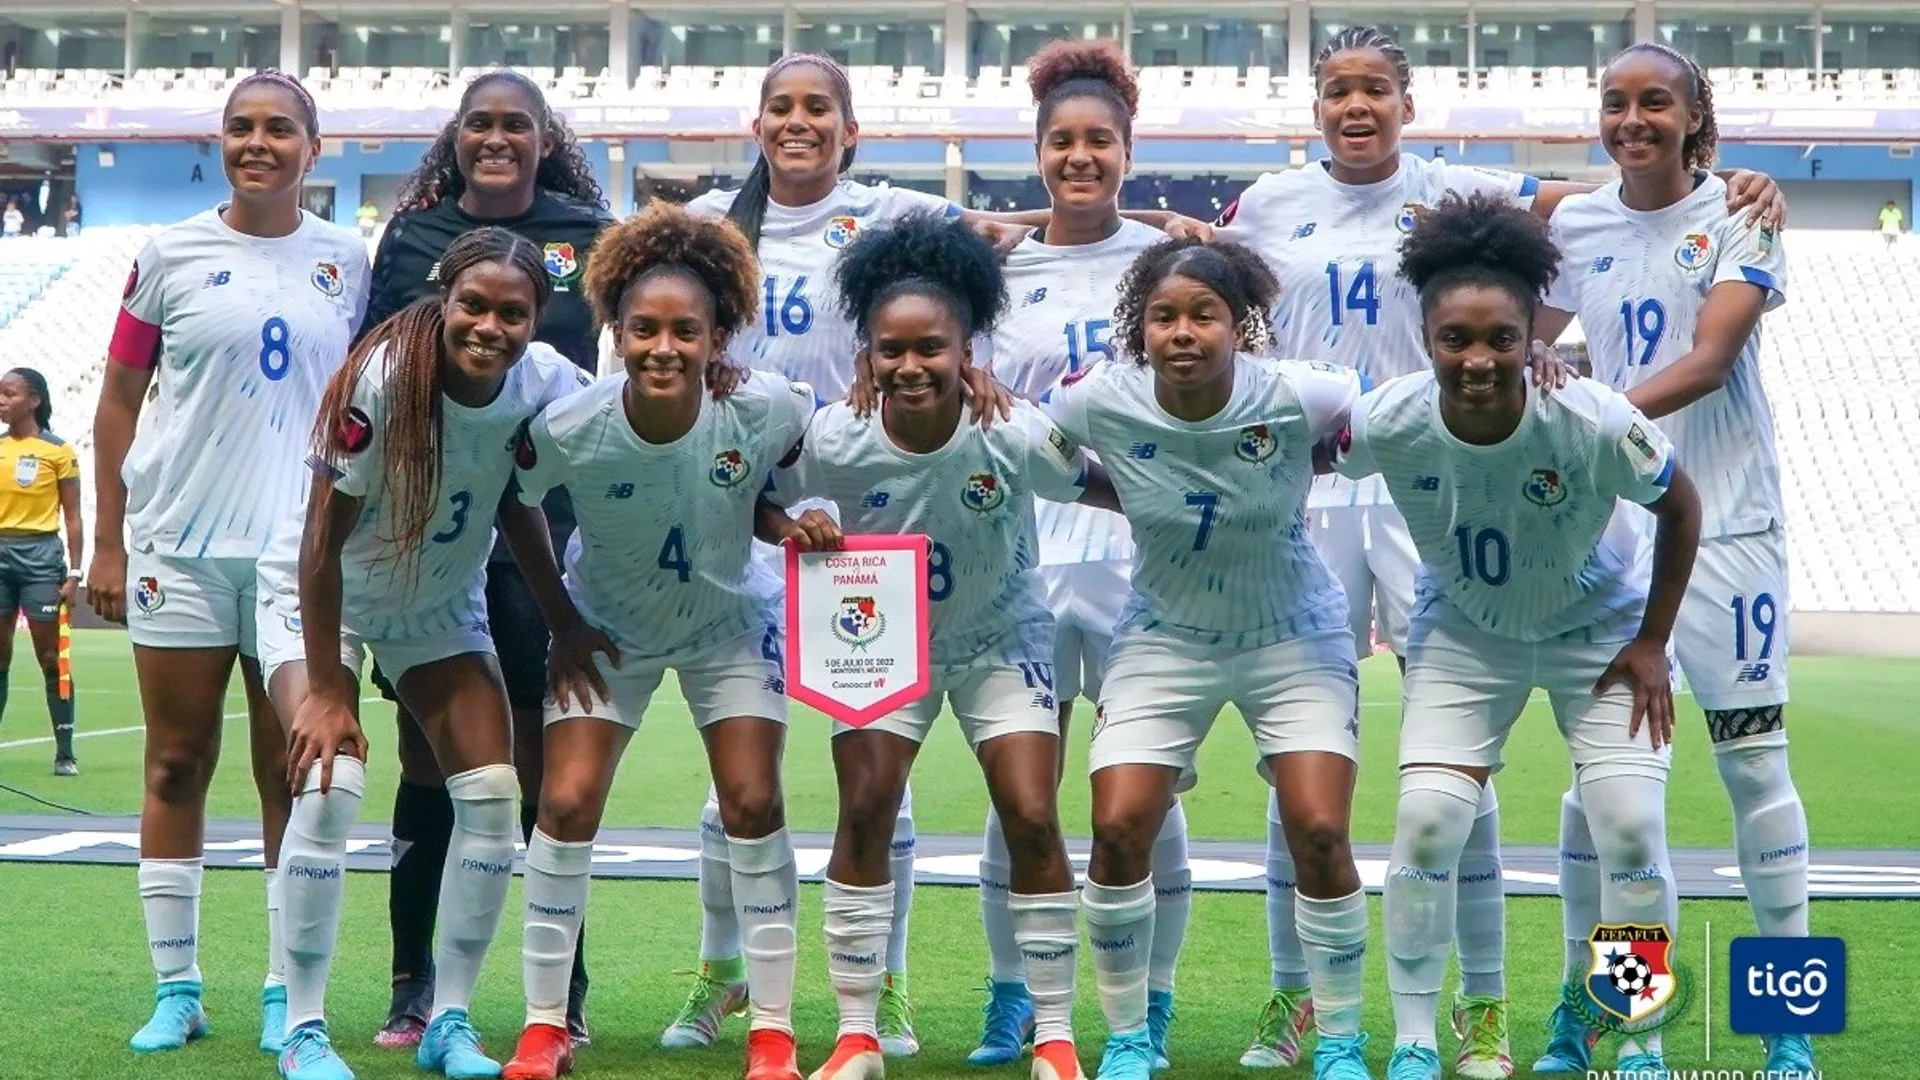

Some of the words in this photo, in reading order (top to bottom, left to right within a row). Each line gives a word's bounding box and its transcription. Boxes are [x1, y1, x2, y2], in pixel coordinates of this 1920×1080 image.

[190, 164, 203, 182] A
[1811, 160, 1822, 178] F
[763, 275, 814, 336] 16
[1325, 259, 1381, 325] 14
[260, 317, 290, 381] 8
[1063, 318, 1117, 374] 15
[1620, 299, 1667, 366] 19
[431, 490, 473, 544] 3
[1184, 491, 1221, 551] 7
[658, 523, 692, 582] 4
[825, 557, 860, 568] COSTA
[862, 556, 887, 567] RICA
[927, 541, 956, 602] 8
[1455, 523, 1511, 586] 10
[1731, 592, 1775, 660] 19
[832, 680, 872, 689] Concacaf
[876, 658, 894, 666] 2022
[1458, 869, 1497, 885] ANAMÁ
